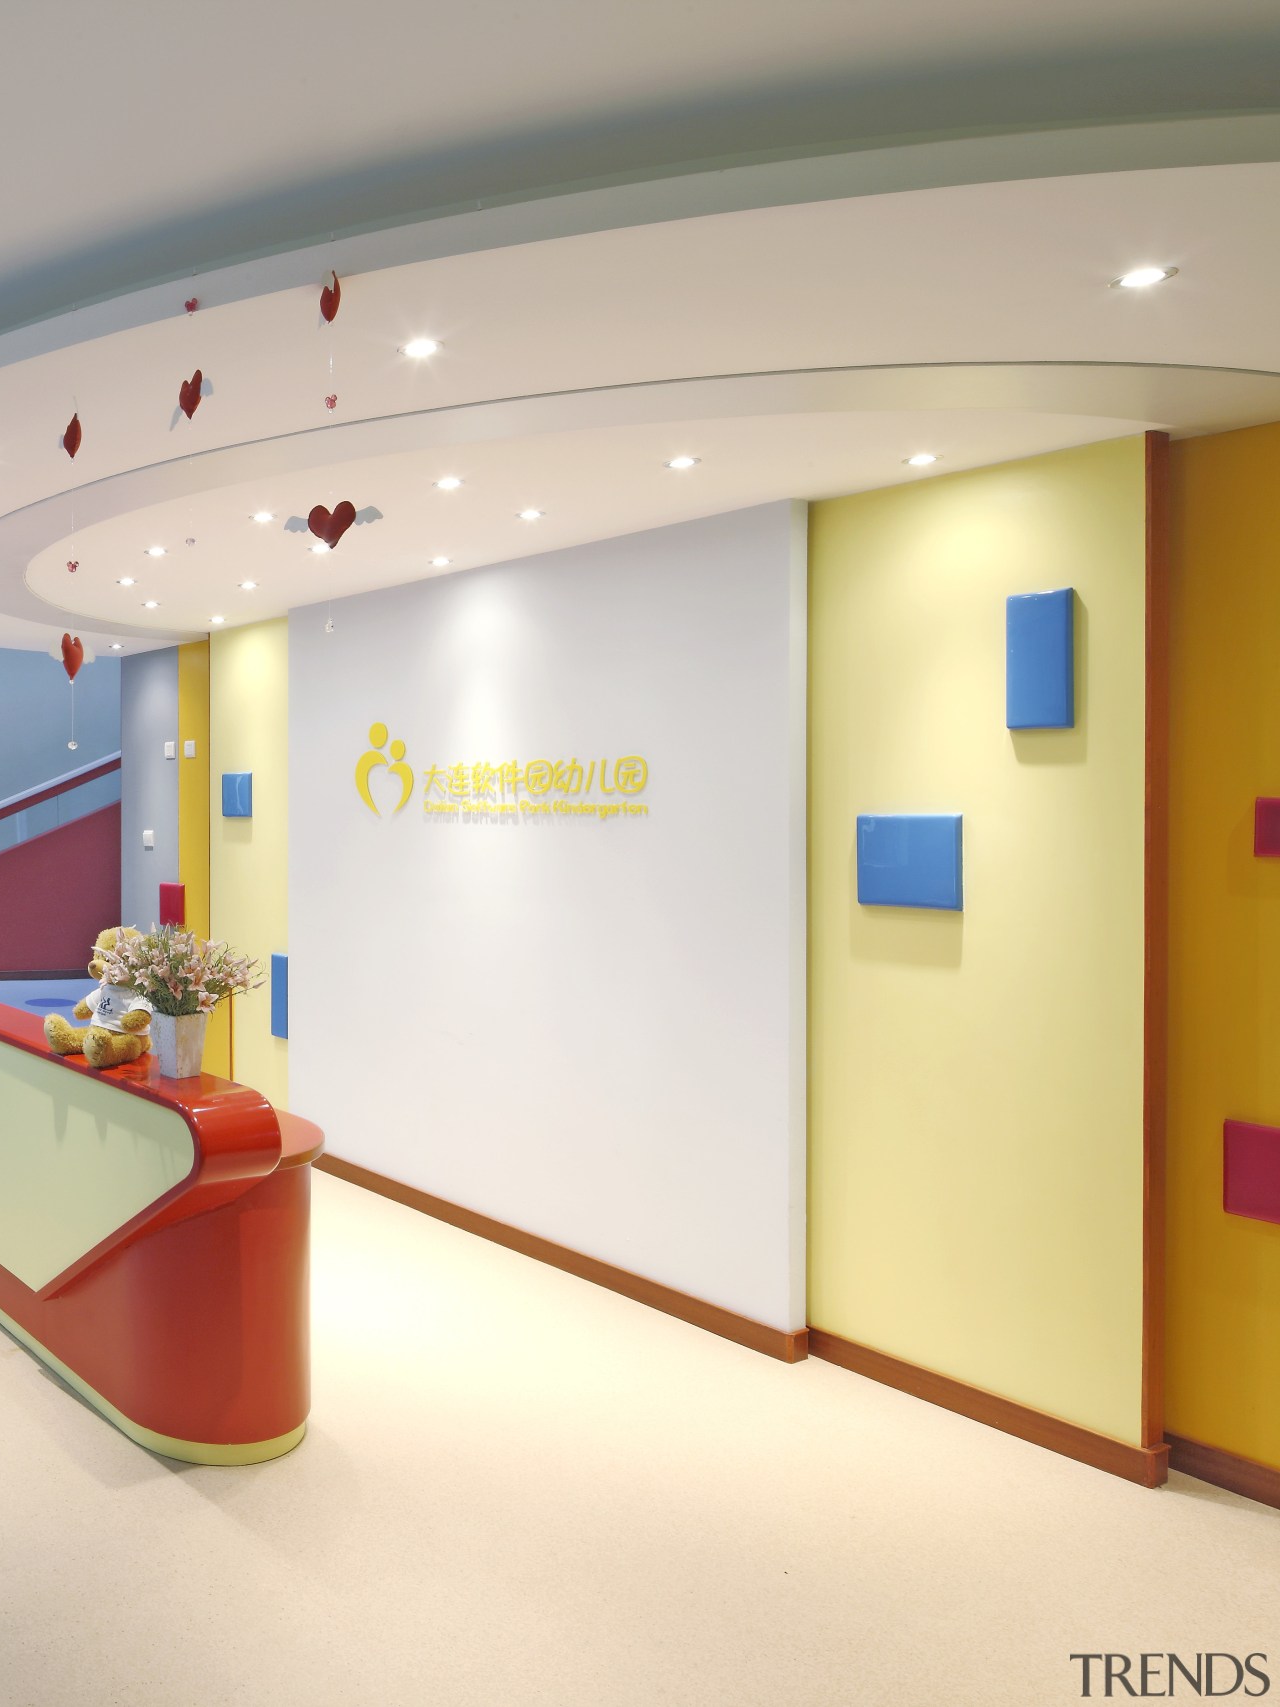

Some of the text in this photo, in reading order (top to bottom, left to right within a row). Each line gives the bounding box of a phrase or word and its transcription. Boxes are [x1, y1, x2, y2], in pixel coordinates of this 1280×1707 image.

[423, 756, 648, 795] 大连软件园幼儿园
[519, 800, 550, 814] Park
[553, 800, 648, 818] Kindergarten
